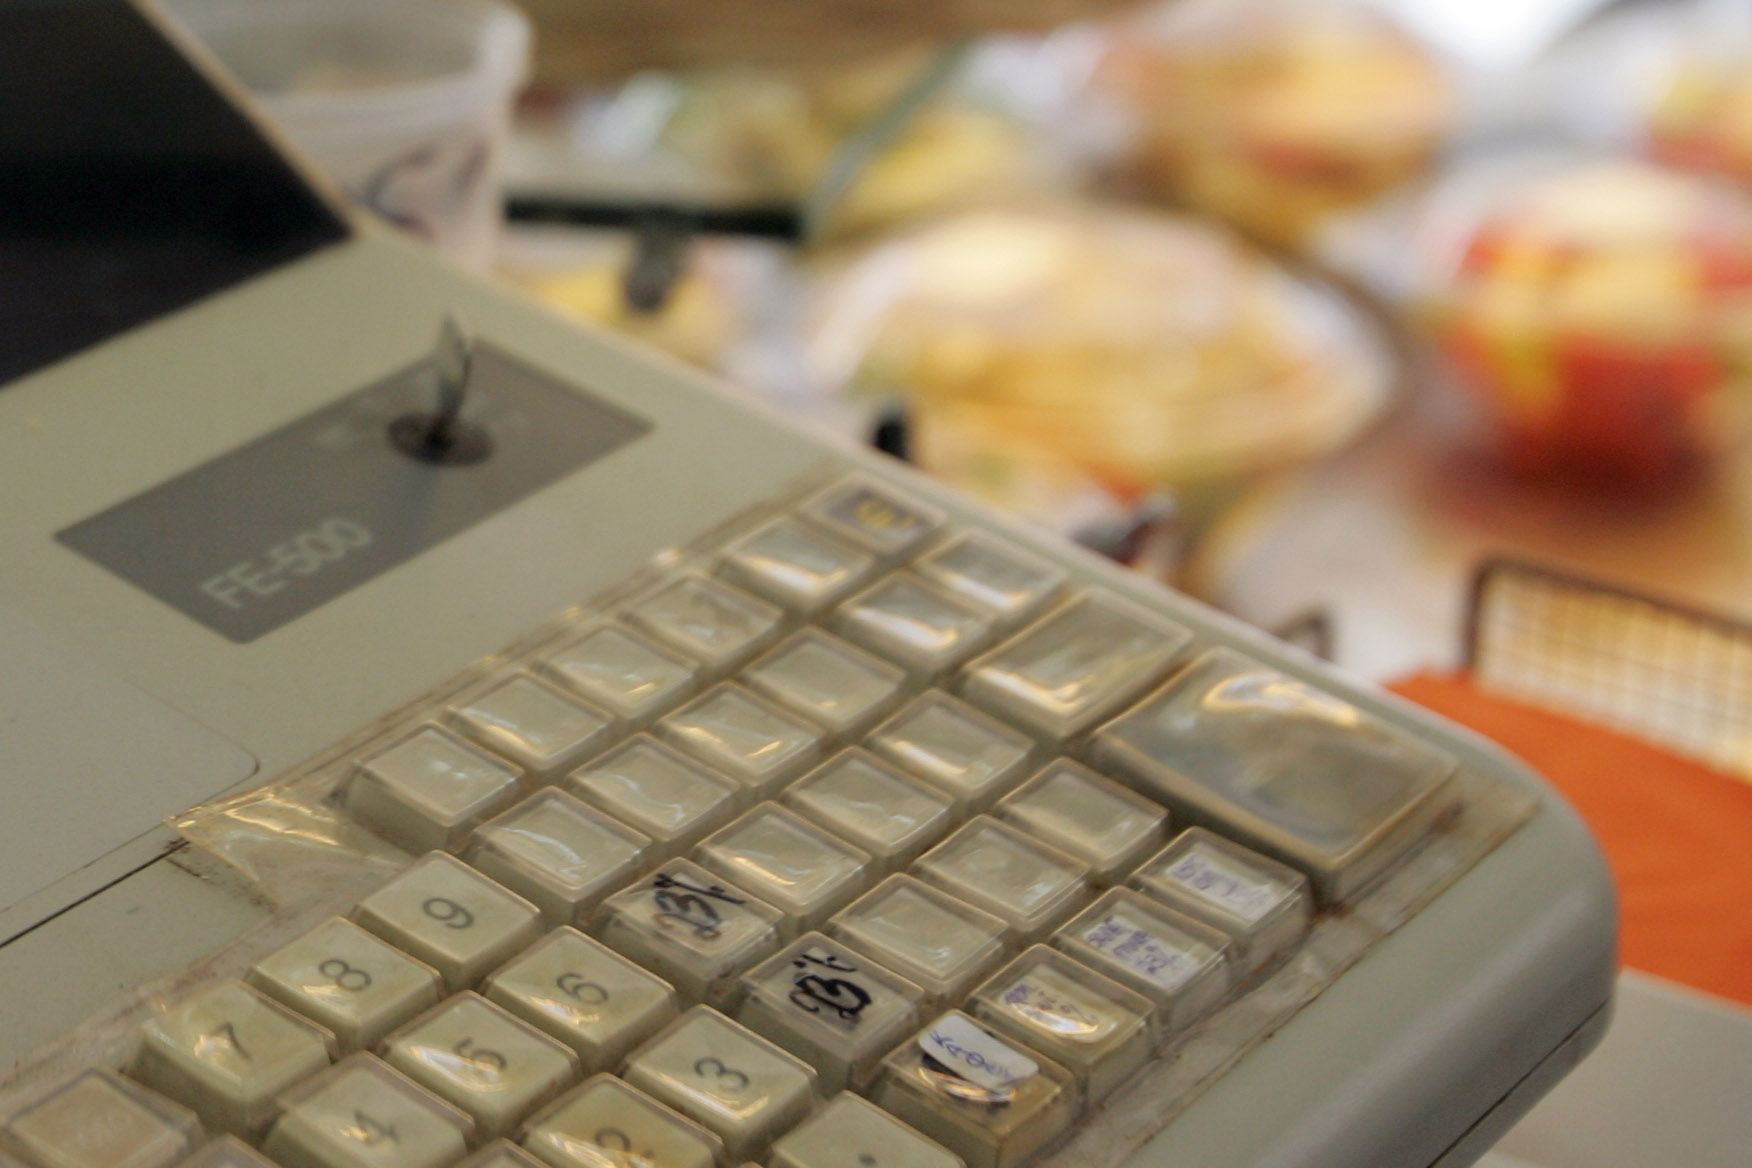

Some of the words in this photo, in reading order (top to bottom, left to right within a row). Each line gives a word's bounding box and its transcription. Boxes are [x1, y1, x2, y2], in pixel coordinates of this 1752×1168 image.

[197, 516, 374, 611] FE-500
[421, 896, 475, 930] 9
[317, 958, 373, 992] 8
[555, 972, 610, 1007] 6
[209, 1020, 253, 1061] 7
[454, 1036, 508, 1074] 5
[693, 1056, 751, 1094] 3
[352, 1108, 403, 1147] 4
